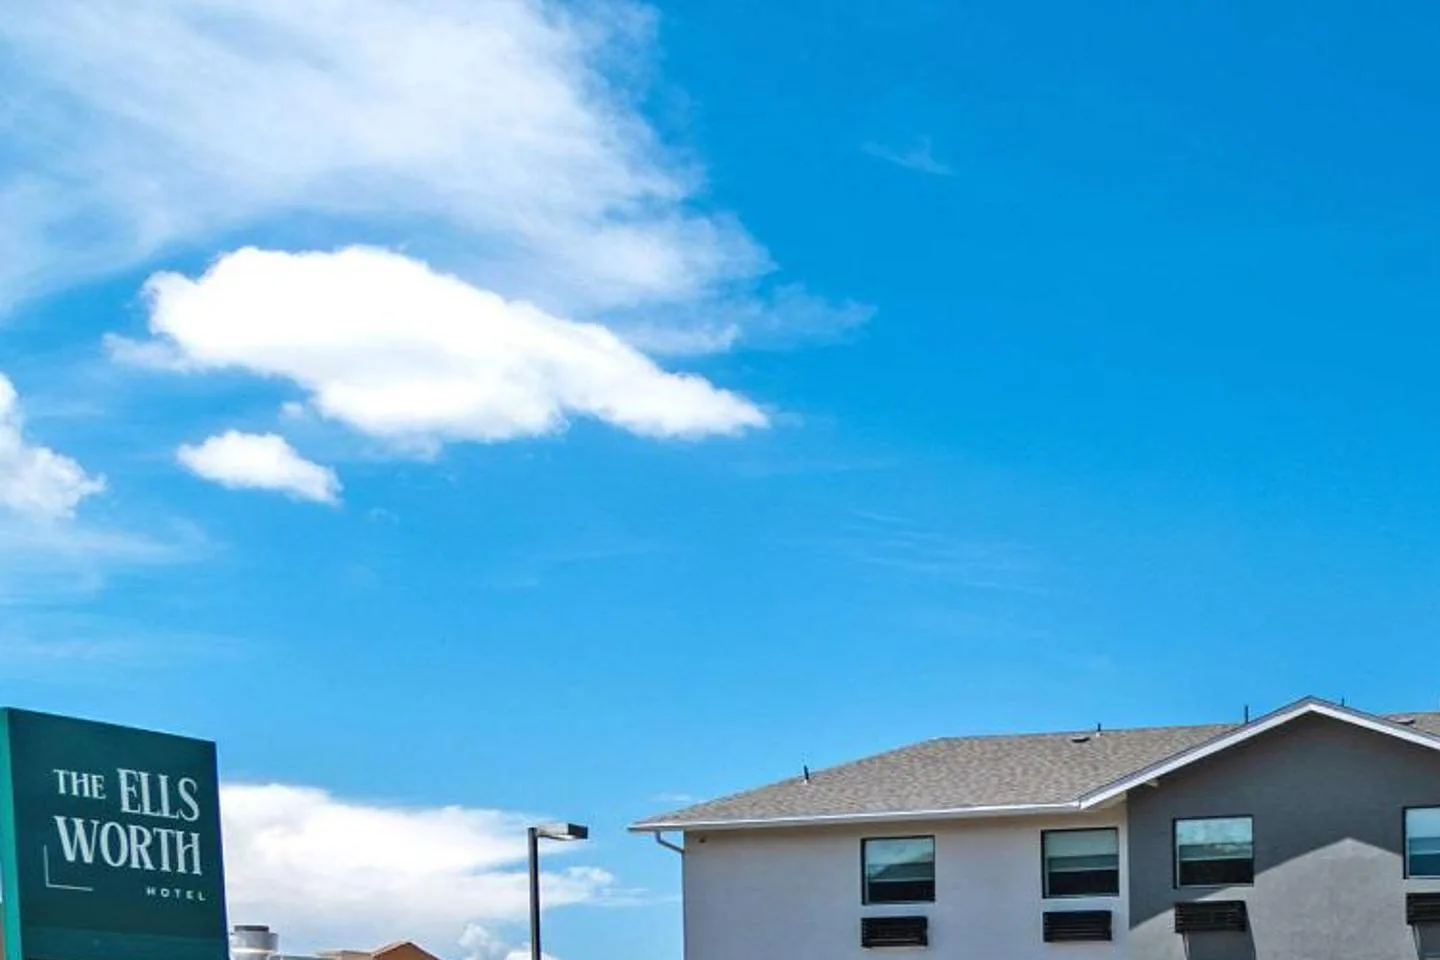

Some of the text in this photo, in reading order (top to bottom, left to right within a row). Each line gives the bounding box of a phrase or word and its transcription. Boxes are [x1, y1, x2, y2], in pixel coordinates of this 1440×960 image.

[53, 768, 200, 821] THE ELLS
[53, 815, 202, 875] WORTH
[146, 887, 206, 901] HOTEL
